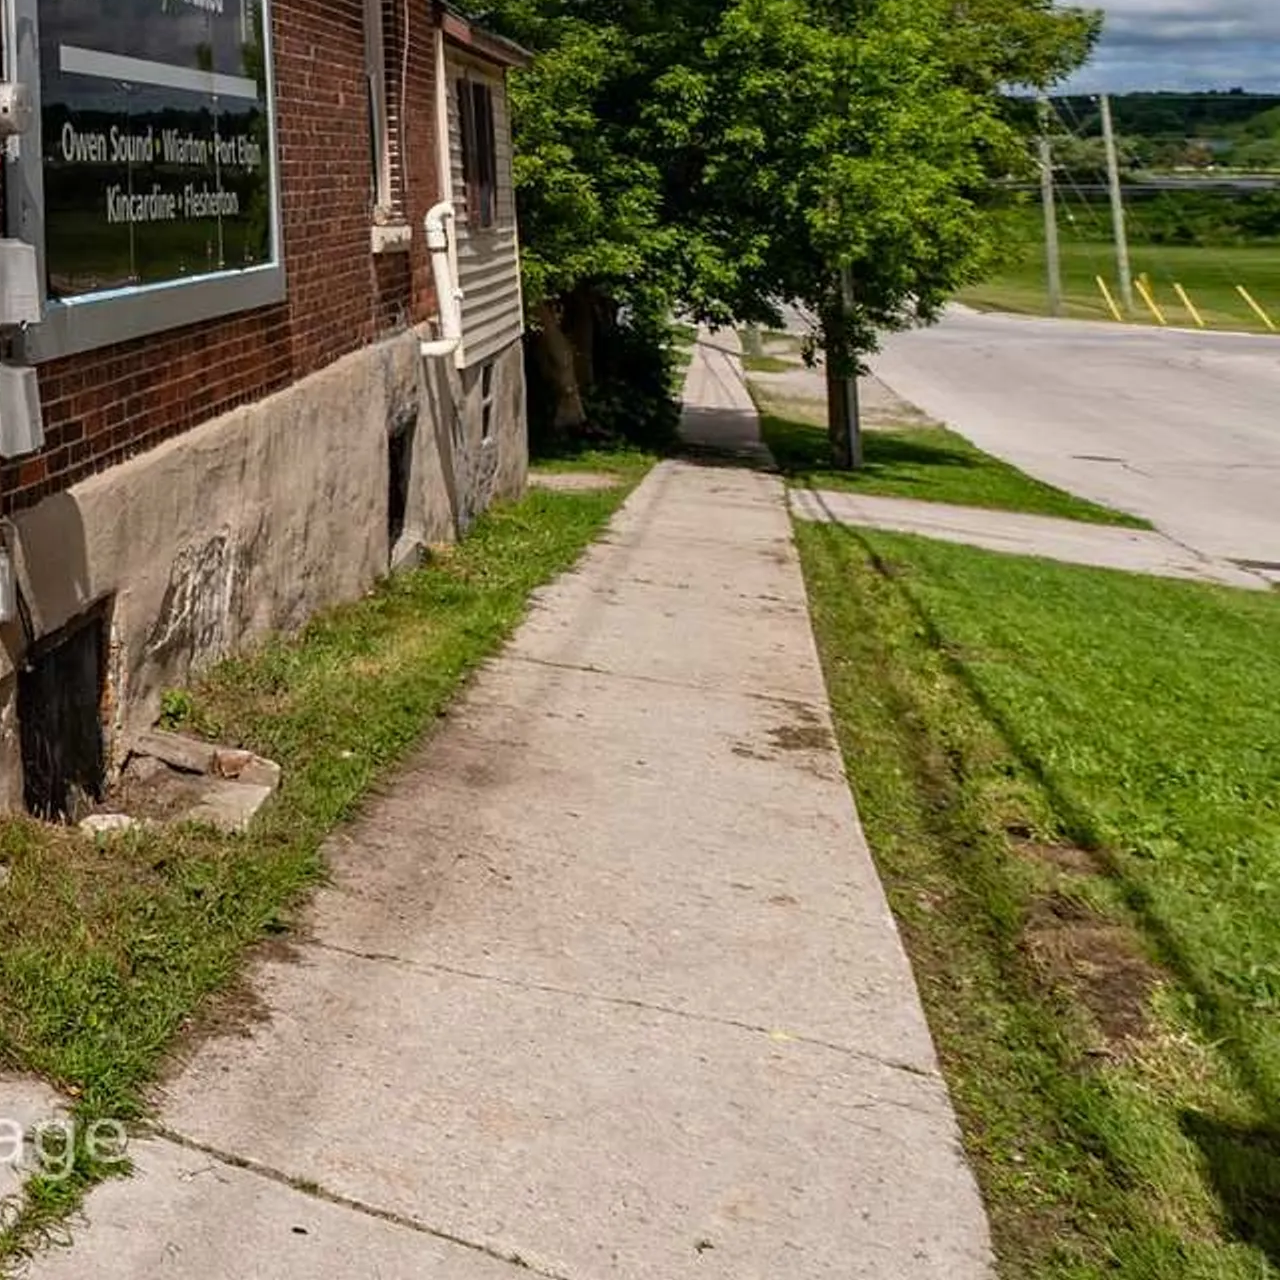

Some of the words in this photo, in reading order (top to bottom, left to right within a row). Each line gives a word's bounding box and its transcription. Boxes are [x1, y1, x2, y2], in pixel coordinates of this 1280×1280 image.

[61, 121, 108, 162] Owen
[109, 124, 154, 162] Sound
[106, 182, 176, 224] Kincardine
